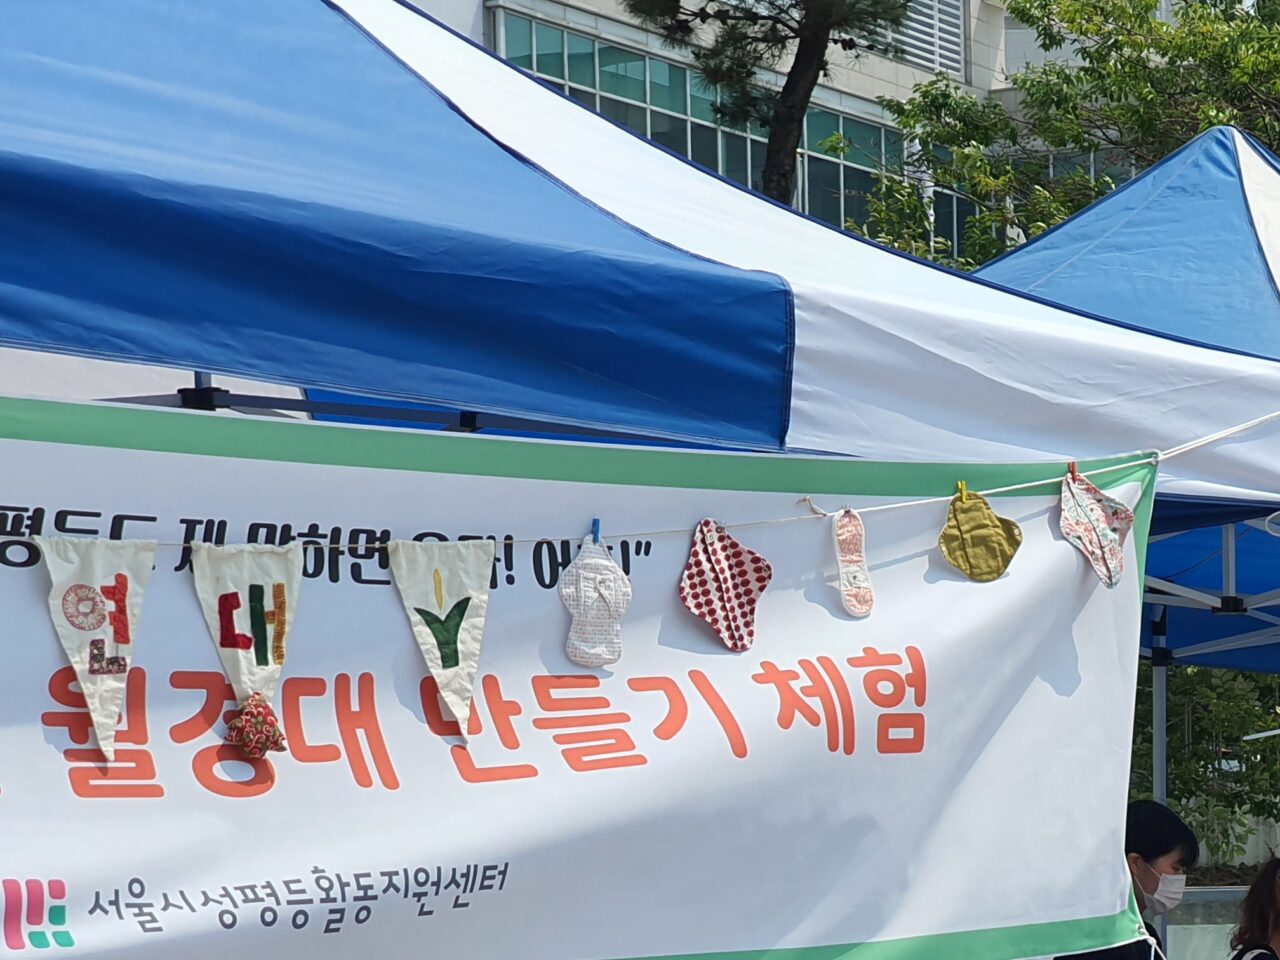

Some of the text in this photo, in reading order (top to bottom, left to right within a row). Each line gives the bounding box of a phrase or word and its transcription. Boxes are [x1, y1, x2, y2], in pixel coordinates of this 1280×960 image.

[419, 669, 749, 784] 만들기
[751, 645, 928, 756] 체험
[88, 861, 510, 934] 서울시성평등활동지원센터
